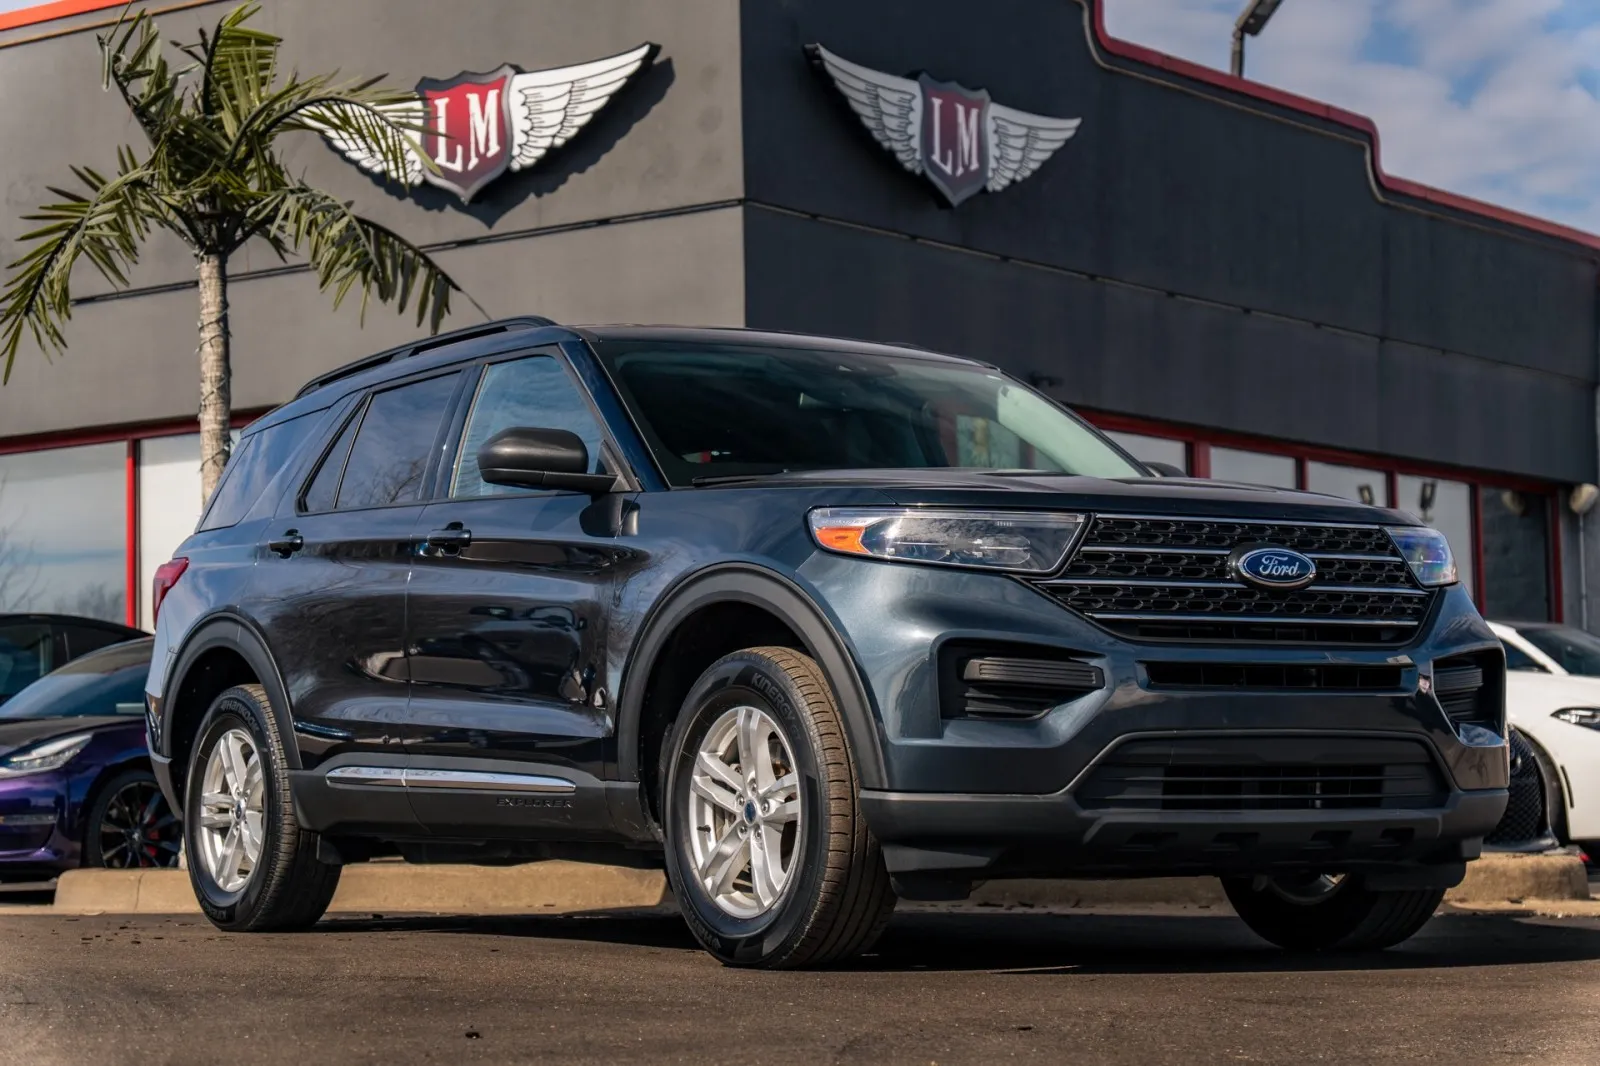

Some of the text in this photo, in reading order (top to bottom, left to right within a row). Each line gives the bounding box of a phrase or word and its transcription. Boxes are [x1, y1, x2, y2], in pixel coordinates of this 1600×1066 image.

[434, 89, 500, 172] LM
[931, 97, 979, 177] LM
[1260, 555, 1299, 576] Ford
[496, 798, 573, 808] EXPLORER
